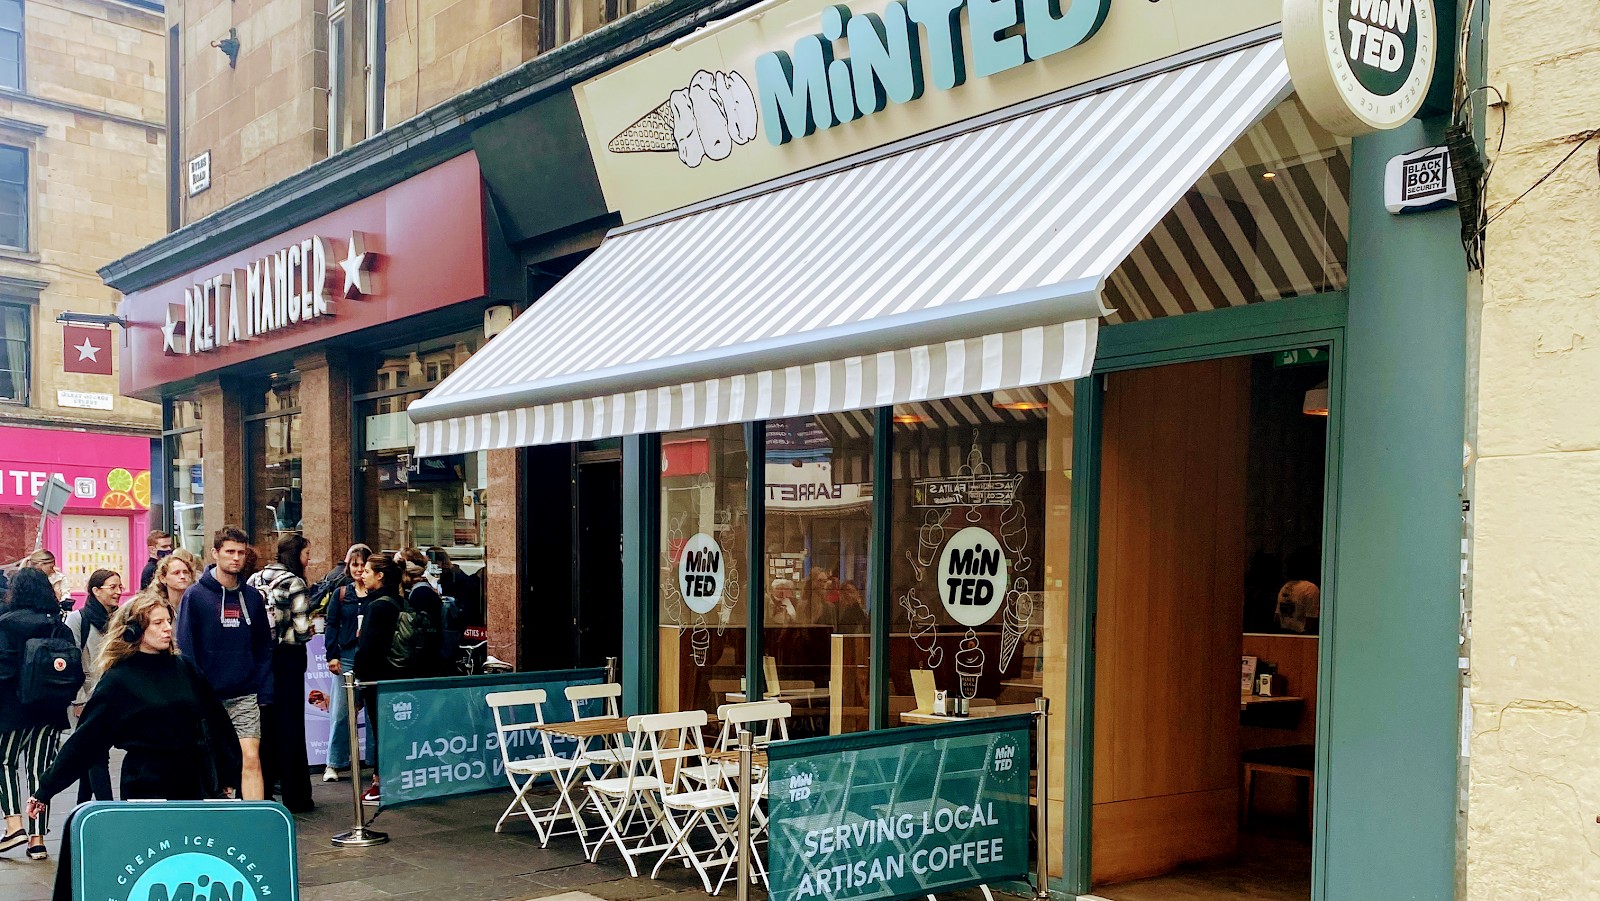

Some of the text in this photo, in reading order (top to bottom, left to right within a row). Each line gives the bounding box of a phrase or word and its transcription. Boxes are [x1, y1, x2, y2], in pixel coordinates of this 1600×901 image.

[1348, 18, 1404, 73] TED
[755, 0, 1106, 147] MiNTED
[1408, 159, 1441, 173] BLACK
[1408, 168, 1441, 187] BOX
[1407, 182, 1441, 194] SECURITY
[184, 234, 328, 356] PRET A MANGER
[686, 546, 720, 573] MiN
[949, 543, 1000, 576] MiN
[685, 574, 717, 598] TED
[946, 577, 995, 606] TED
[994, 744, 1015, 760] MiN
[994, 757, 1013, 772] TED
[789, 771, 813, 789] MiN
[789, 785, 811, 803] TED
[804, 801, 999, 858] SERVING LOCAL
[117, 839, 171, 886] CREAM
[184, 835, 215, 848] ICE
[226, 846, 272, 897] CREAM
[796, 837, 1004, 901] ARTISAN COFFEE
